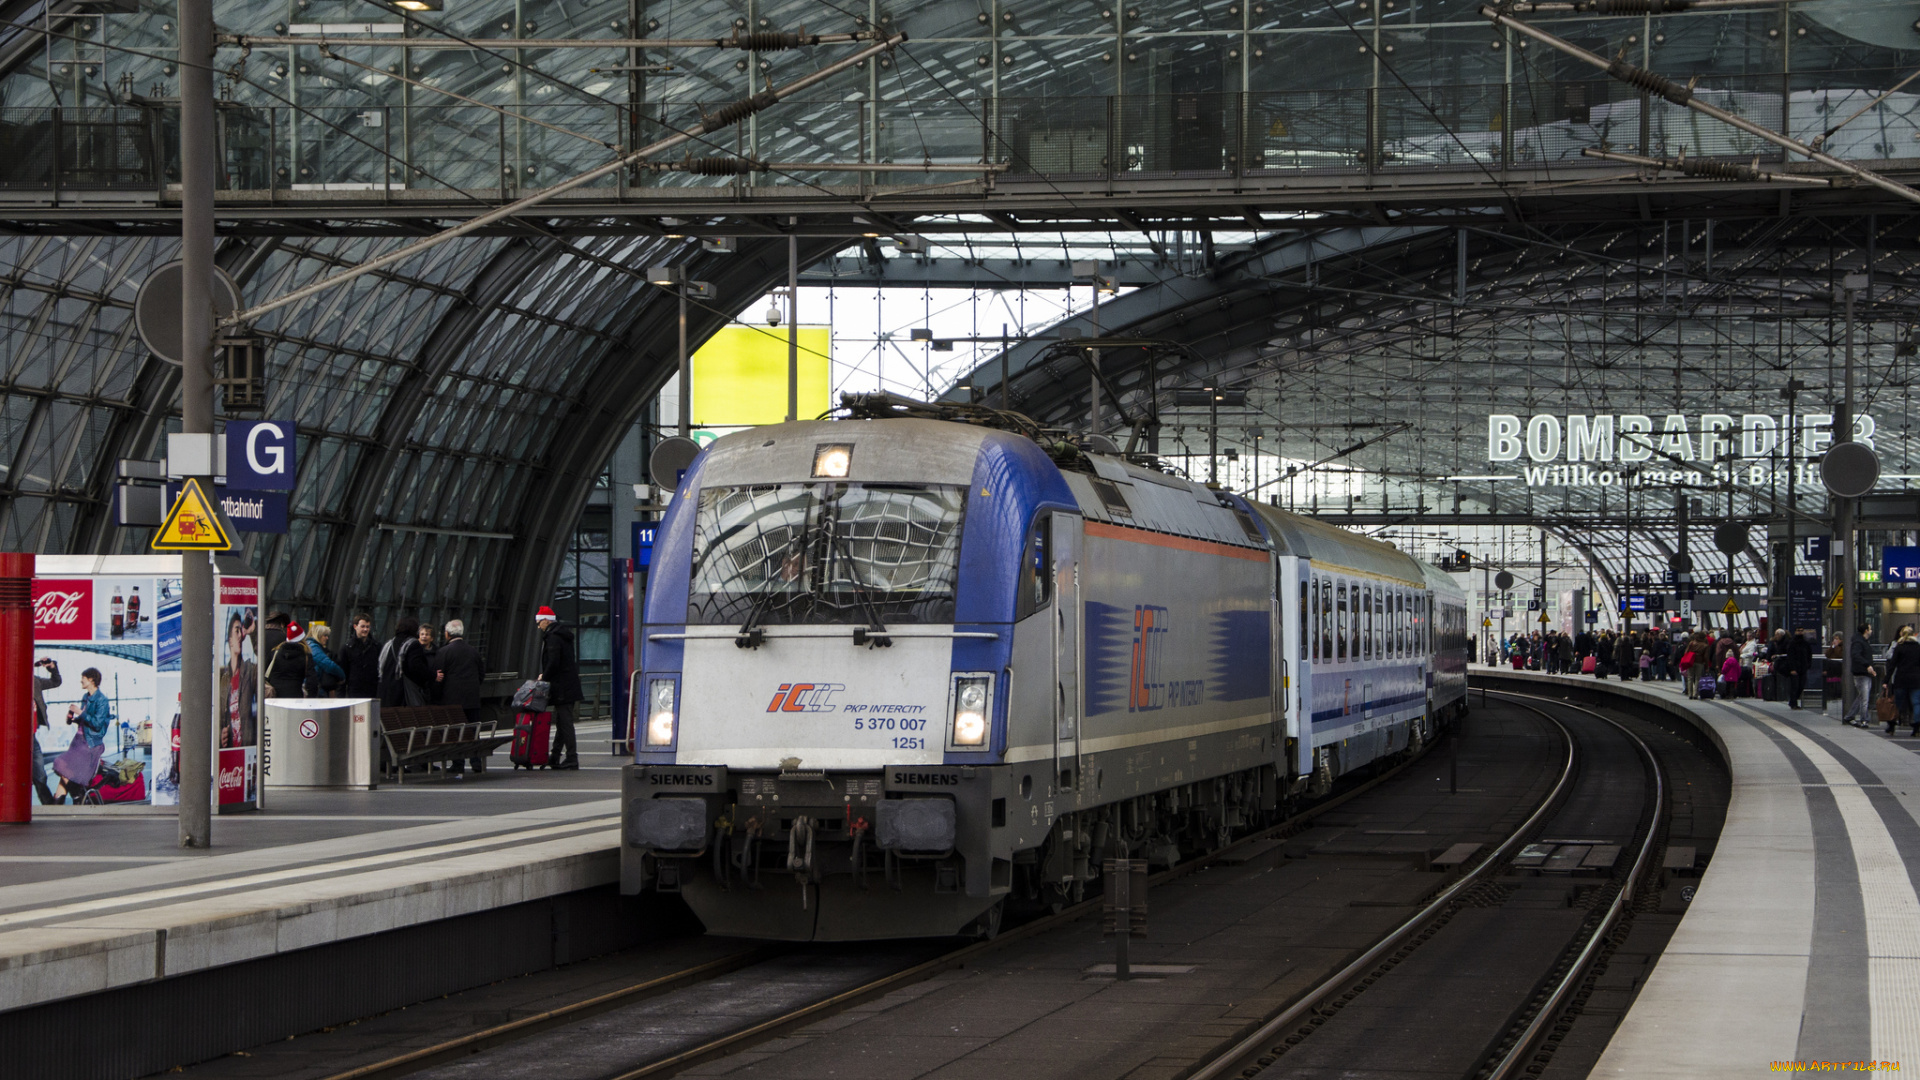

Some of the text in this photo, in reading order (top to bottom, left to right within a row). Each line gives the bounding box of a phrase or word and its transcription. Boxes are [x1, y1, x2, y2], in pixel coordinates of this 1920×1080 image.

[246, 422, 285, 475] G
[1524, 464, 1701, 486] Willkommen
[1712, 464, 1738, 485] in
[640, 529, 653, 542] 11
[1807, 537, 1820, 556] F
[1635, 575, 1647, 583] 13
[1664, 571, 1673, 583] E
[1713, 574, 1724, 583] 14
[1529, 600, 1537, 609] D
[158, 637, 177, 649] Berlin
[843, 704, 927, 714] PKP INTERCITY
[854, 718, 927, 731] 5 370 007
[892, 737, 925, 749] 1251
[651, 774, 713, 786] SIEMENS
[894, 772, 958, 786] SIEMENS
